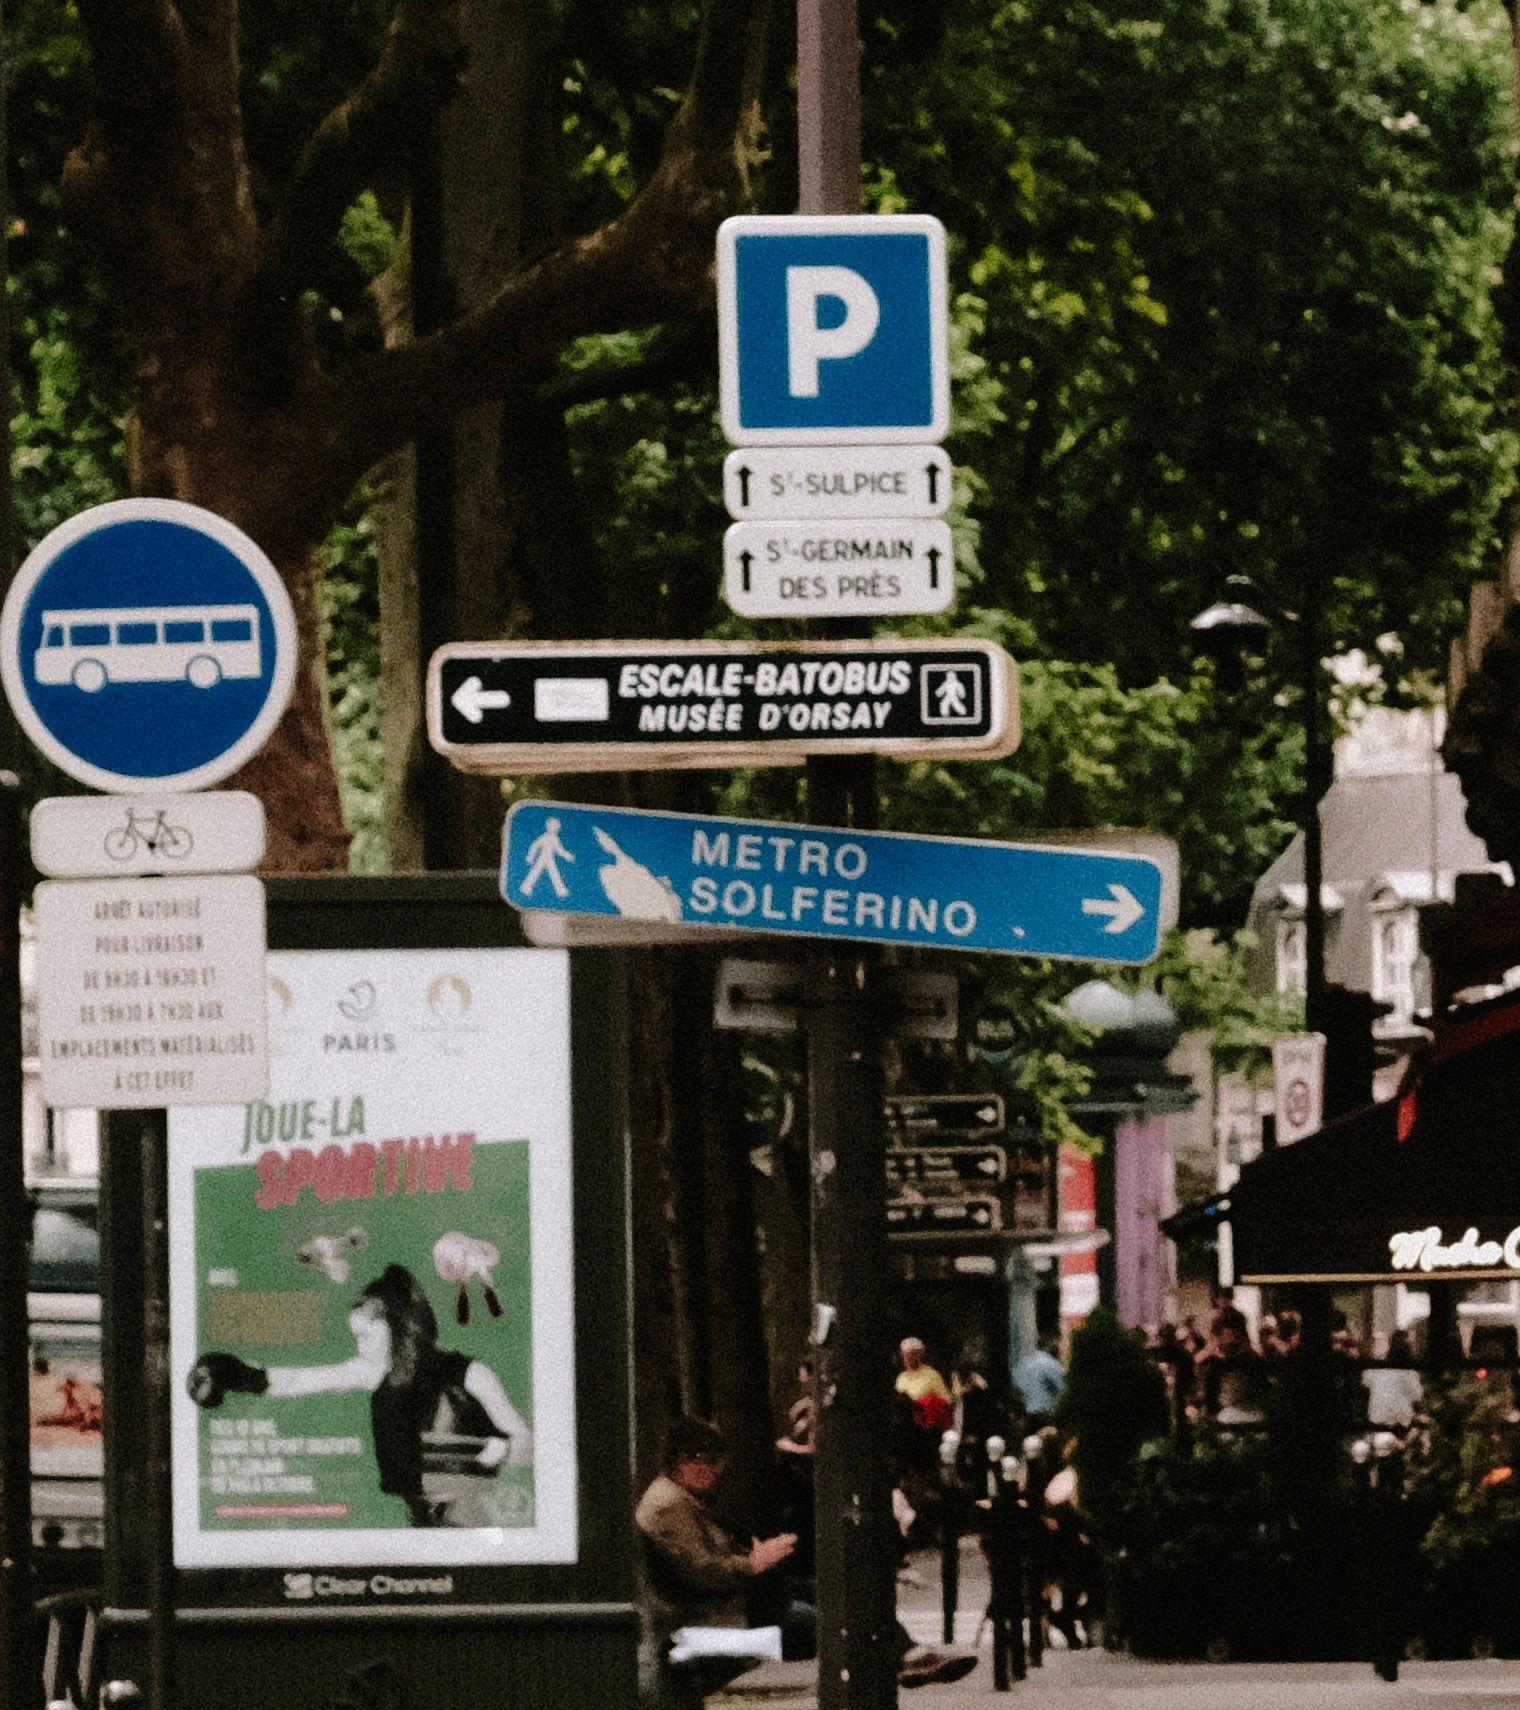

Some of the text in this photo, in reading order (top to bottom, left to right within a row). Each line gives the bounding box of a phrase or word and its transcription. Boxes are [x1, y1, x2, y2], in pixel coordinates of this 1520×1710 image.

[786, 266, 880, 398] P
[779, 576, 827, 600] DES
[618, 660, 911, 698] ESCALE-BATOBUS
[758, 701, 891, 732] D'ORSAY
[691, 829, 869, 881] METRO
[689, 876, 978, 938] SOLFERINO
[323, 1033, 397, 1051] PARIS
[241, 1093, 366, 1155] JOUE-LA
[255, 1131, 477, 1210] SPORTIVE
[314, 1576, 367, 1596] Clear
